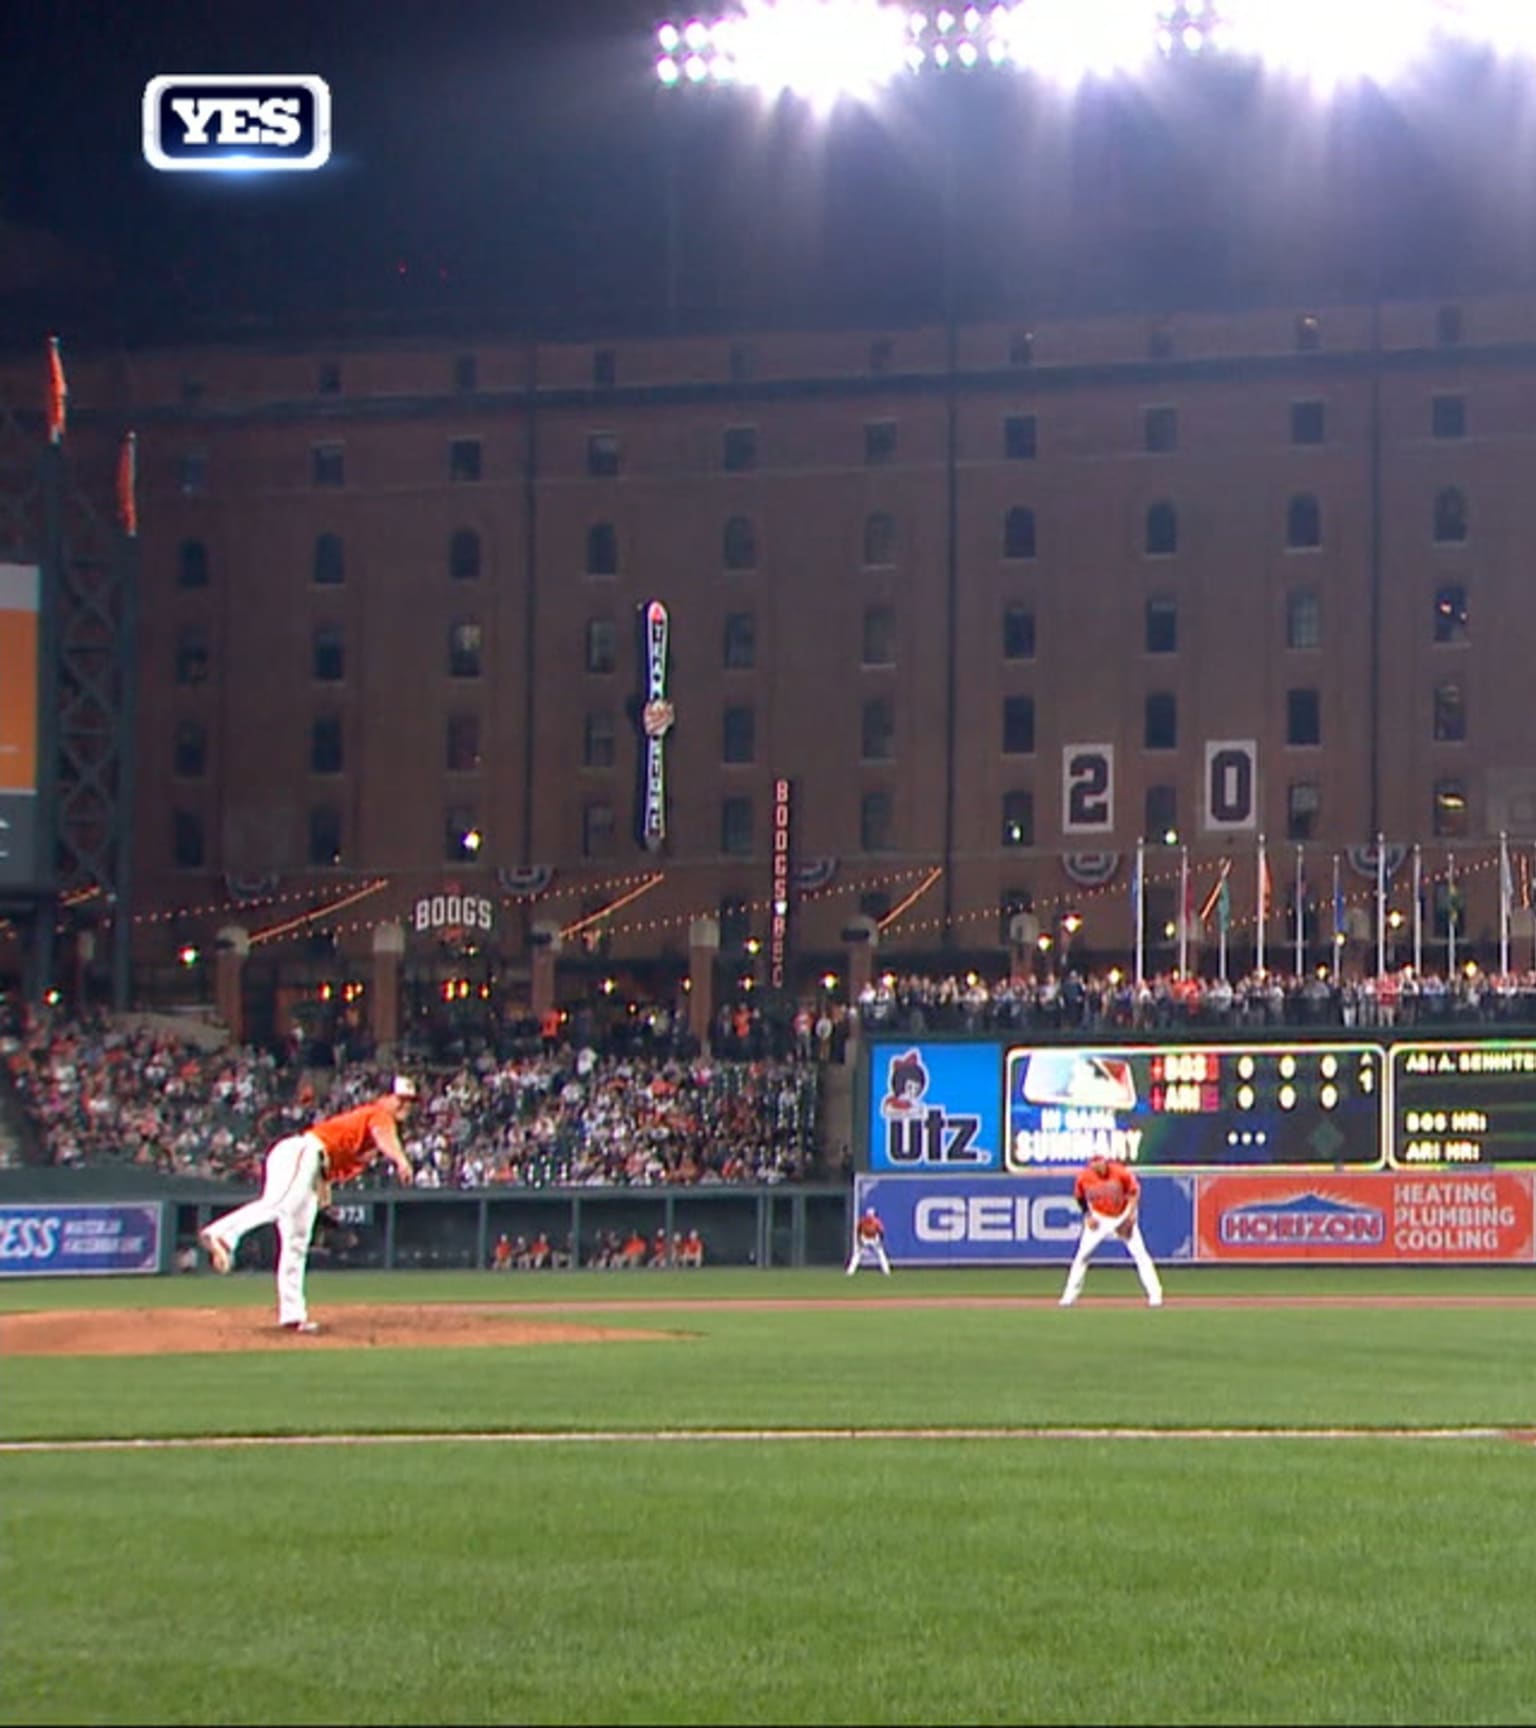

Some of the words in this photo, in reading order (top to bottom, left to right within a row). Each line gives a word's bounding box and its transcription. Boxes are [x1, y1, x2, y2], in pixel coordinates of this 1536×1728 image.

[416, 896, 492, 931] BOOGS
[1393, 1183, 1496, 1204] HEATING
[914, 1196, 1084, 1241] GEIC
[1225, 1214, 1381, 1239] HORIZON
[1393, 1206, 1516, 1228] PLUMBING
[0, 1217, 60, 1258] ESS
[1393, 1229, 1500, 1250] COOLING
